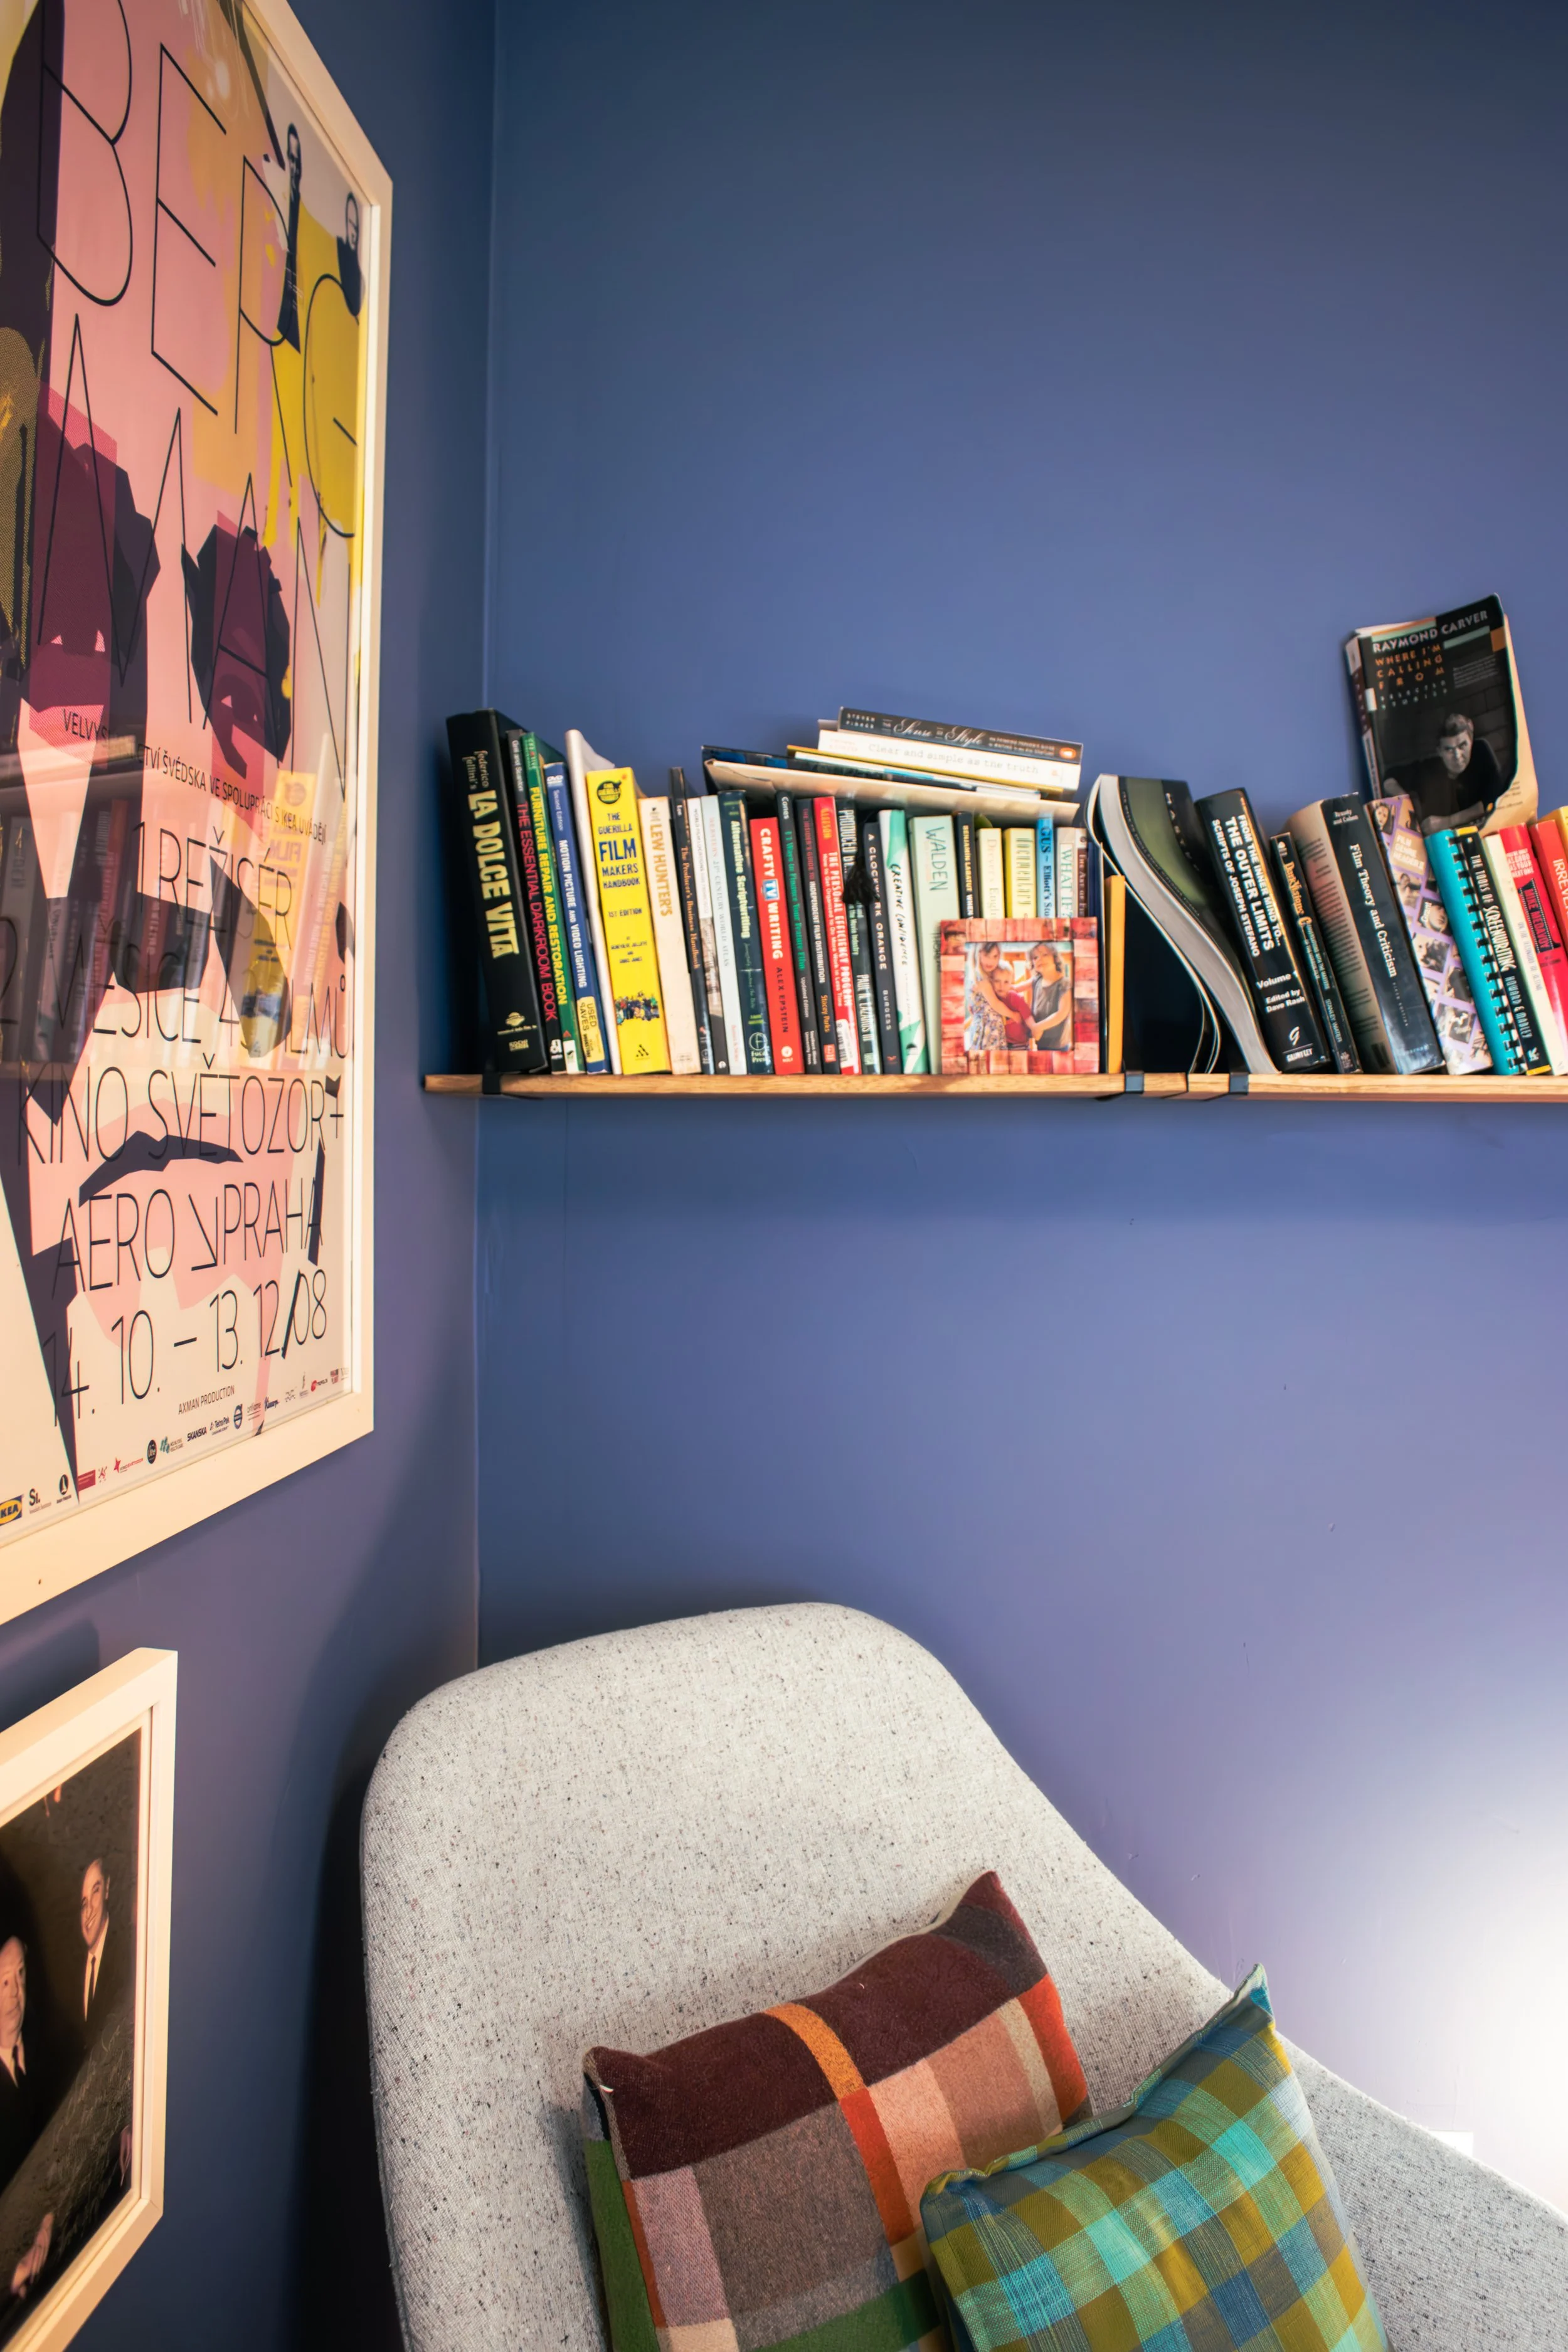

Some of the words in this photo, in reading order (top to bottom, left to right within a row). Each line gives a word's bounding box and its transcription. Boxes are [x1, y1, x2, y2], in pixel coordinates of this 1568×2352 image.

[1373, 629, 1438, 653] RAYMOND
[1442, 610, 1488, 634] CARVER
[1375, 650, 1416, 666] WHERE
[1422, 644, 1441, 656] I'M
[1377, 654, 1443, 678] CALLING
[1379, 667, 1444, 690] FROM
[462, 756, 477, 790] fellini's
[474, 750, 489, 788] federico
[868, 744, 898, 755] Clear
[903, 750, 923, 758] and
[927, 752, 964, 766] simple
[984, 760, 1002, 769] the
[1006, 763, 1039, 774] truth
[163, 747, 206, 792] ŠVÉDSKA
[209, 775, 220, 798] VE
[281, 809, 297, 832] IKEA
[468, 790, 498, 820] LA
[553, 790, 561, 810] Second
[517, 801, 530, 827] THE
[530, 787, 547, 850] FURNITURE
[607, 812, 620, 821] THE
[781, 797, 790, 820] Cones
[598, 824, 633, 835] GUERILLA
[650, 822, 664, 854] LEW
[839, 809, 858, 853] PRODUCED
[868, 834, 875, 842] A
[1041, 827, 1052, 854] GUS
[1212, 819, 1231, 859] SCRIPTS
[472, 820, 511, 899] DOLCE
[559, 839, 571, 872] MOTION
[598, 838, 637, 862] FILM
[731, 820, 744, 874] Alternative
[760, 828, 775, 877] CRAFTY
[828, 852, 839, 867] THE
[924, 826, 949, 891] WALDEN
[1350, 844, 1364, 869] Film
[1470, 854, 1483, 869] THE
[520, 828, 539, 901] ESSENTIAL
[538, 852, 553, 895] REPAIR
[602, 864, 638, 877] MAKERS
[682, 862, 691, 900] Producer's
[965, 862, 973, 892] LABATUT
[1016, 838, 1034, 905] documentary
[1061, 849, 1073, 889] WHAT
[1224, 860, 1236, 874] OF
[1238, 814, 1253, 843] FROM
[1247, 843, 1259, 864] THE
[1253, 864, 1268, 896] INNER
[1263, 894, 1278, 922] MIND
[1475, 869, 1491, 892] TOOLS
[563, 874, 576, 908] PICTURE
[603, 878, 640, 889] HANDBOOK
[653, 854, 673, 917] HUNTER'S
[763, 879, 779, 900] TV
[789, 873, 797, 902] Finance
[830, 867, 842, 913] PERSONAL
[869, 847, 882, 917] CLOCKWRK
[889, 863, 904, 909] CREATIVE
[1043, 866, 1052, 899] Elliott's
[1226, 816, 1244, 847] THE
[1235, 849, 1259, 899] OUTER
[1250, 901, 1275, 951] LIMITS
[1229, 875, 1247, 913] JOSEPH
[1358, 869, 1375, 907] Theory
[543, 896, 556, 924] AND
[619, 908, 642, 916] EDITION
[736, 875, 750, 939] Scriptwriting
[826, 888, 834, 919] Organized
[1482, 894, 1494, 904] OF
[1524, 888, 1539, 910] MIKE
[485, 901, 519, 960] VITA
[687, 901, 696, 932] Business
[767, 902, 783, 960] WRITING
[809, 881, 820, 924] INDEPENDENT
[815, 941, 825, 983] DISTRIBUTION
[1370, 909, 1385, 930] and
[1530, 911, 1550, 948] MEDAVOY
[529, 902, 551, 979] DARKROOM
[570, 923, 582, 949] VIDEO
[690, 933, 699, 970] Handbook
[793, 923, 803, 949] Feature
[835, 915, 849, 963] EFFICIENCY
[876, 923, 887, 970] ORANGE
[1241, 913, 1261, 957] STEFANO
[1483, 905, 1517, 972] SCREENWRITING
[548, 924, 567, 1005] RESTORATION
[574, 950, 587, 988] LIGHTING
[797, 950, 806, 970] Film
[1377, 930, 1397, 978] Criticism
[776, 967, 785, 990] ALEX
[840, 966, 852, 1007] PROGRAM
[857, 974, 871, 993] PAUL
[1256, 973, 1292, 990] Volume
[1505, 976, 1522, 1005] HOWARD
[541, 982, 558, 1021] BOOK
[820, 995, 829, 1015] Stacey
[882, 990, 892, 1031] BURGESS
[1265, 991, 1290, 1004] Edited
[1291, 989, 1301, 997] by
[1265, 1004, 1285, 1014] Dave
[1286, 996, 1305, 1007] Rash
[1325, 999, 1336, 1019] STANLEY
[580, 1002, 589, 1031] SAVES
[586, 1002, 596, 1027] USED
[778, 995, 788, 1033] EPSTEIN
[822, 1015, 830, 1033] Parks
[18, 1062, 129, 1165] KINO
[147, 1052, 326, 1157] SVĚTOZOR
[51, 1187, 176, 1300] AERO
[223, 1176, 324, 1266] PRAHA
[111, 1309, 161, 1406] 10.
[209, 1289, 244, 1372] 13.
[178, 1397, 199, 1415] AXMAN
[200, 1384, 235, 1406] PRODUCTION
[187, 1426, 207, 1442] SKANSKA
